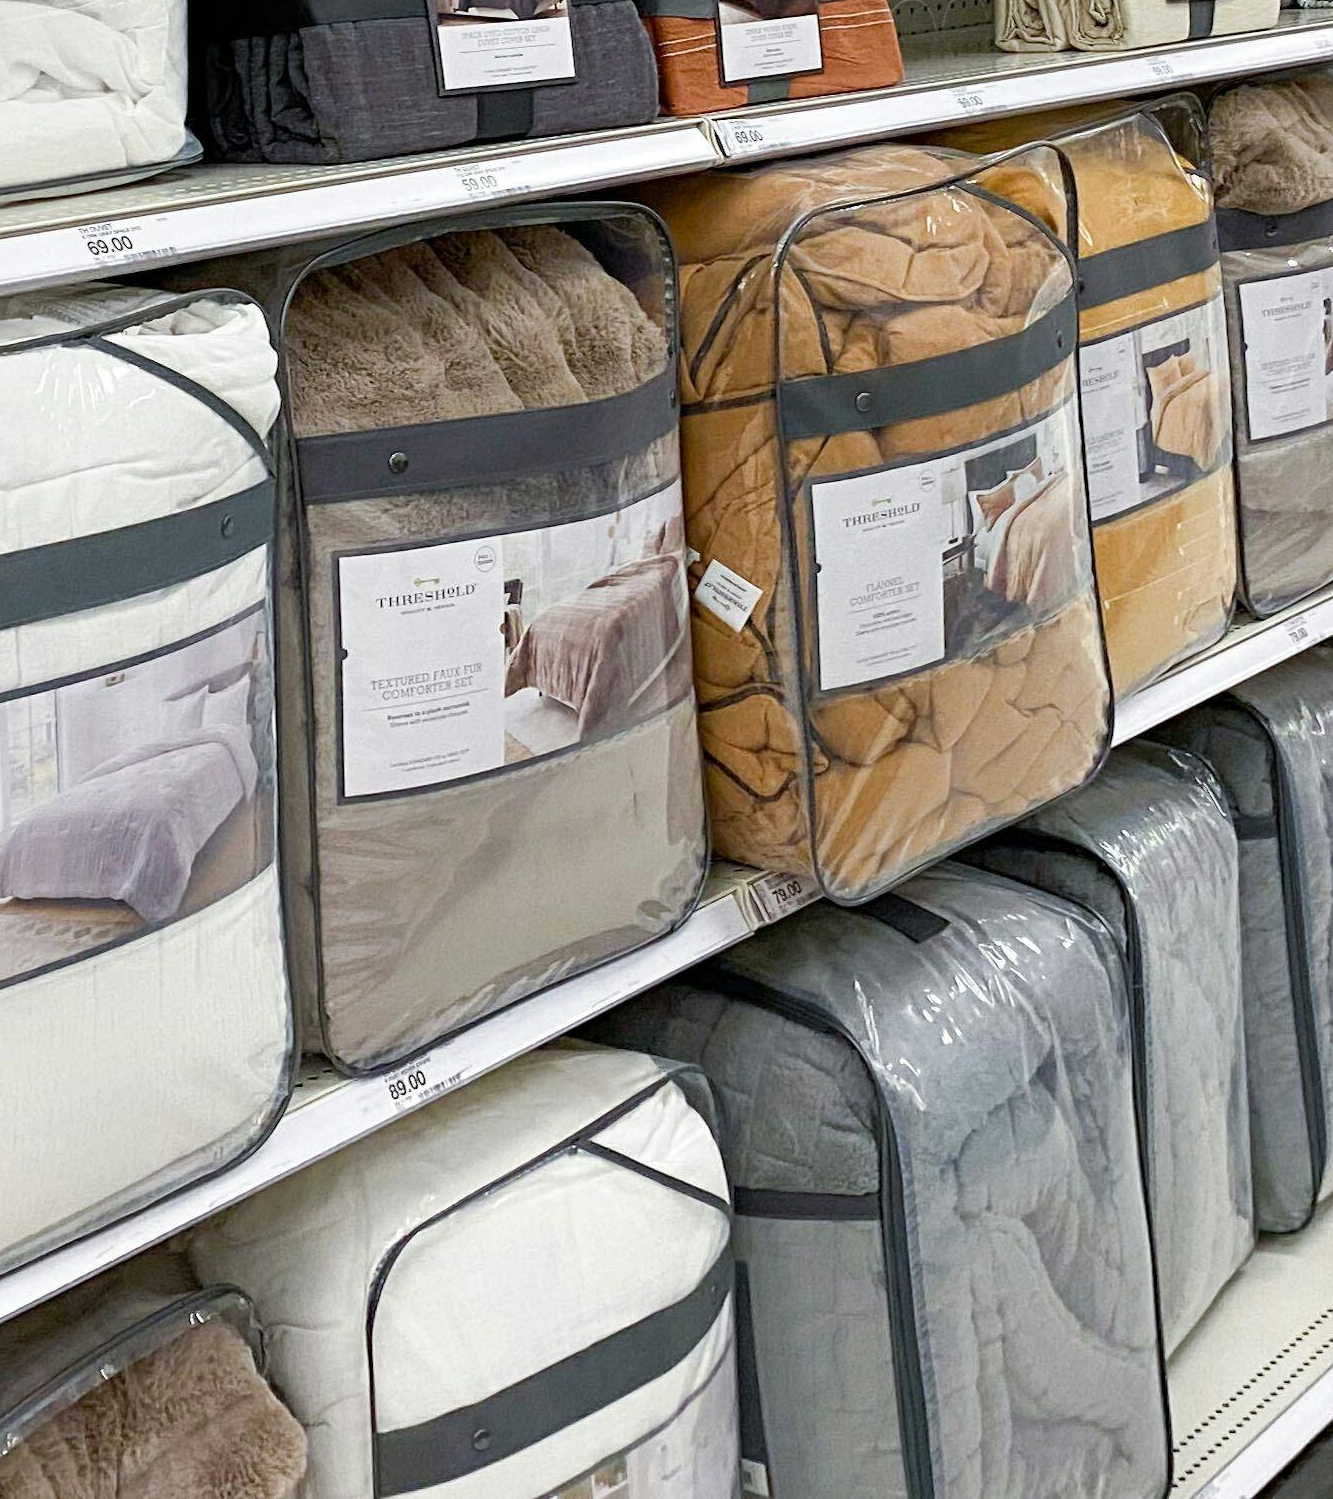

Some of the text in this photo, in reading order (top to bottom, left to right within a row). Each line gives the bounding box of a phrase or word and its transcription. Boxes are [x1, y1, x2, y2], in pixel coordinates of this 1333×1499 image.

[734, 130, 764, 144] 69.00
[461, 175, 498, 192] 59.00
[87, 235, 133, 256] 69.00
[370, 662, 483, 692] TEXTURED FAUX FUR
[381, 676, 474, 702] COMFORTER SET
[772, 880, 802, 904] 79.00
[388, 1070, 426, 1100] 89.00
